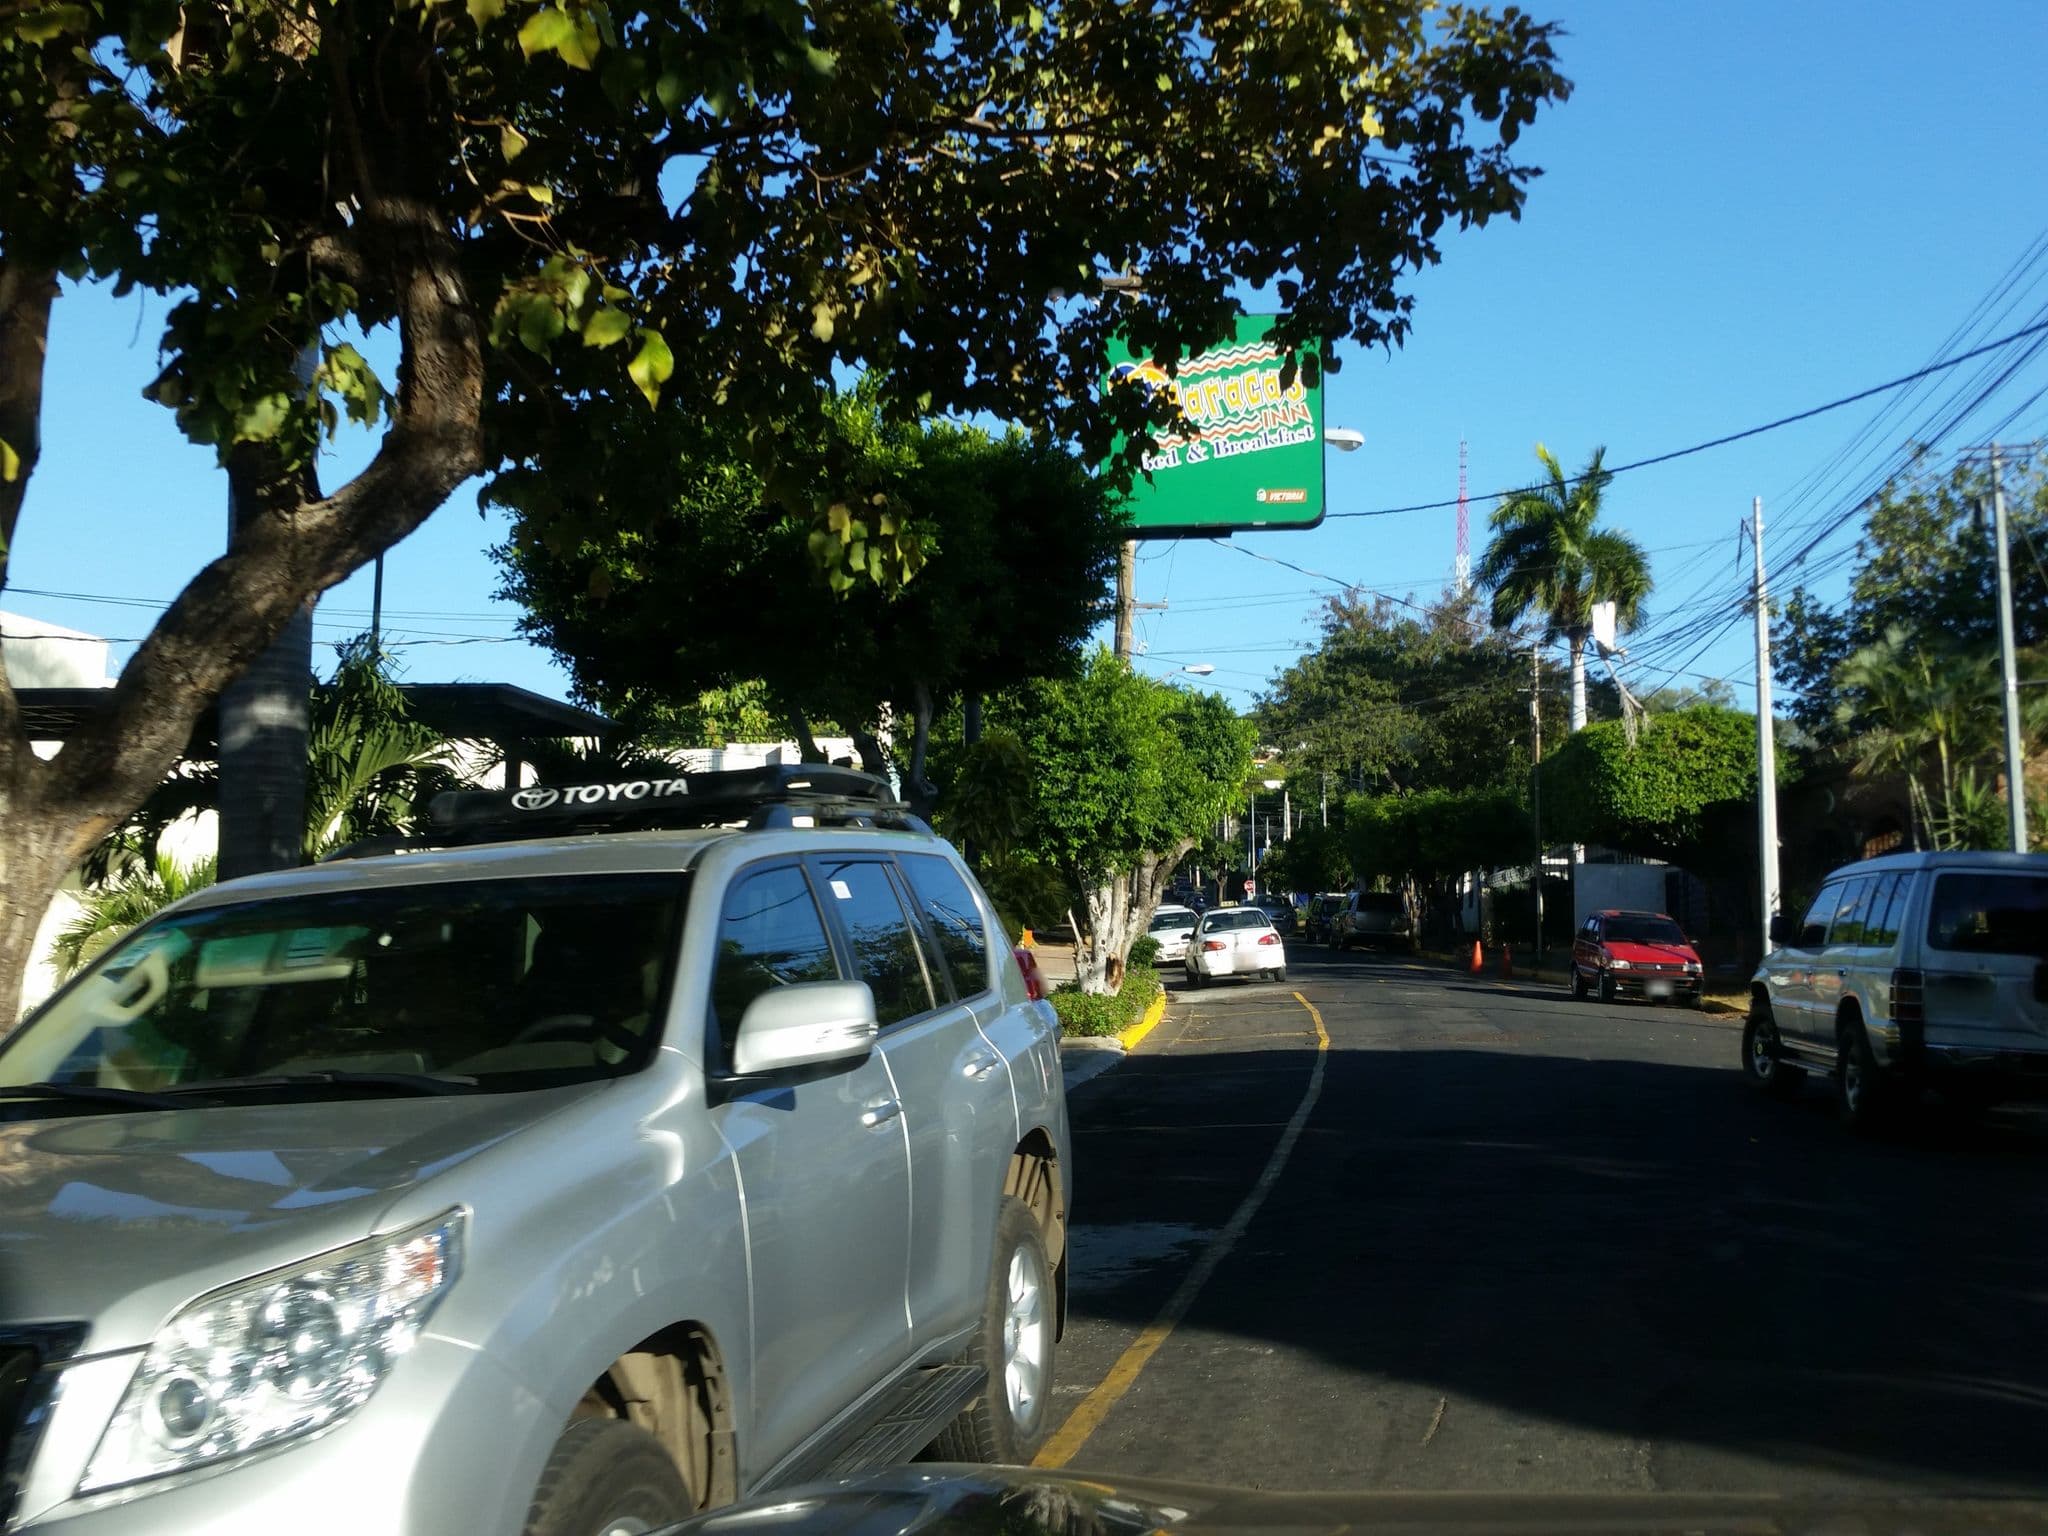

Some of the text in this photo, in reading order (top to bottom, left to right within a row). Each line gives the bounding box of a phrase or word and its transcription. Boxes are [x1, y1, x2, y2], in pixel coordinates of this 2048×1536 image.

[1261, 404, 1311, 429] INN
[1143, 426, 1314, 469] Bed & Breakfast
[563, 778, 689, 804] TOYOTA
